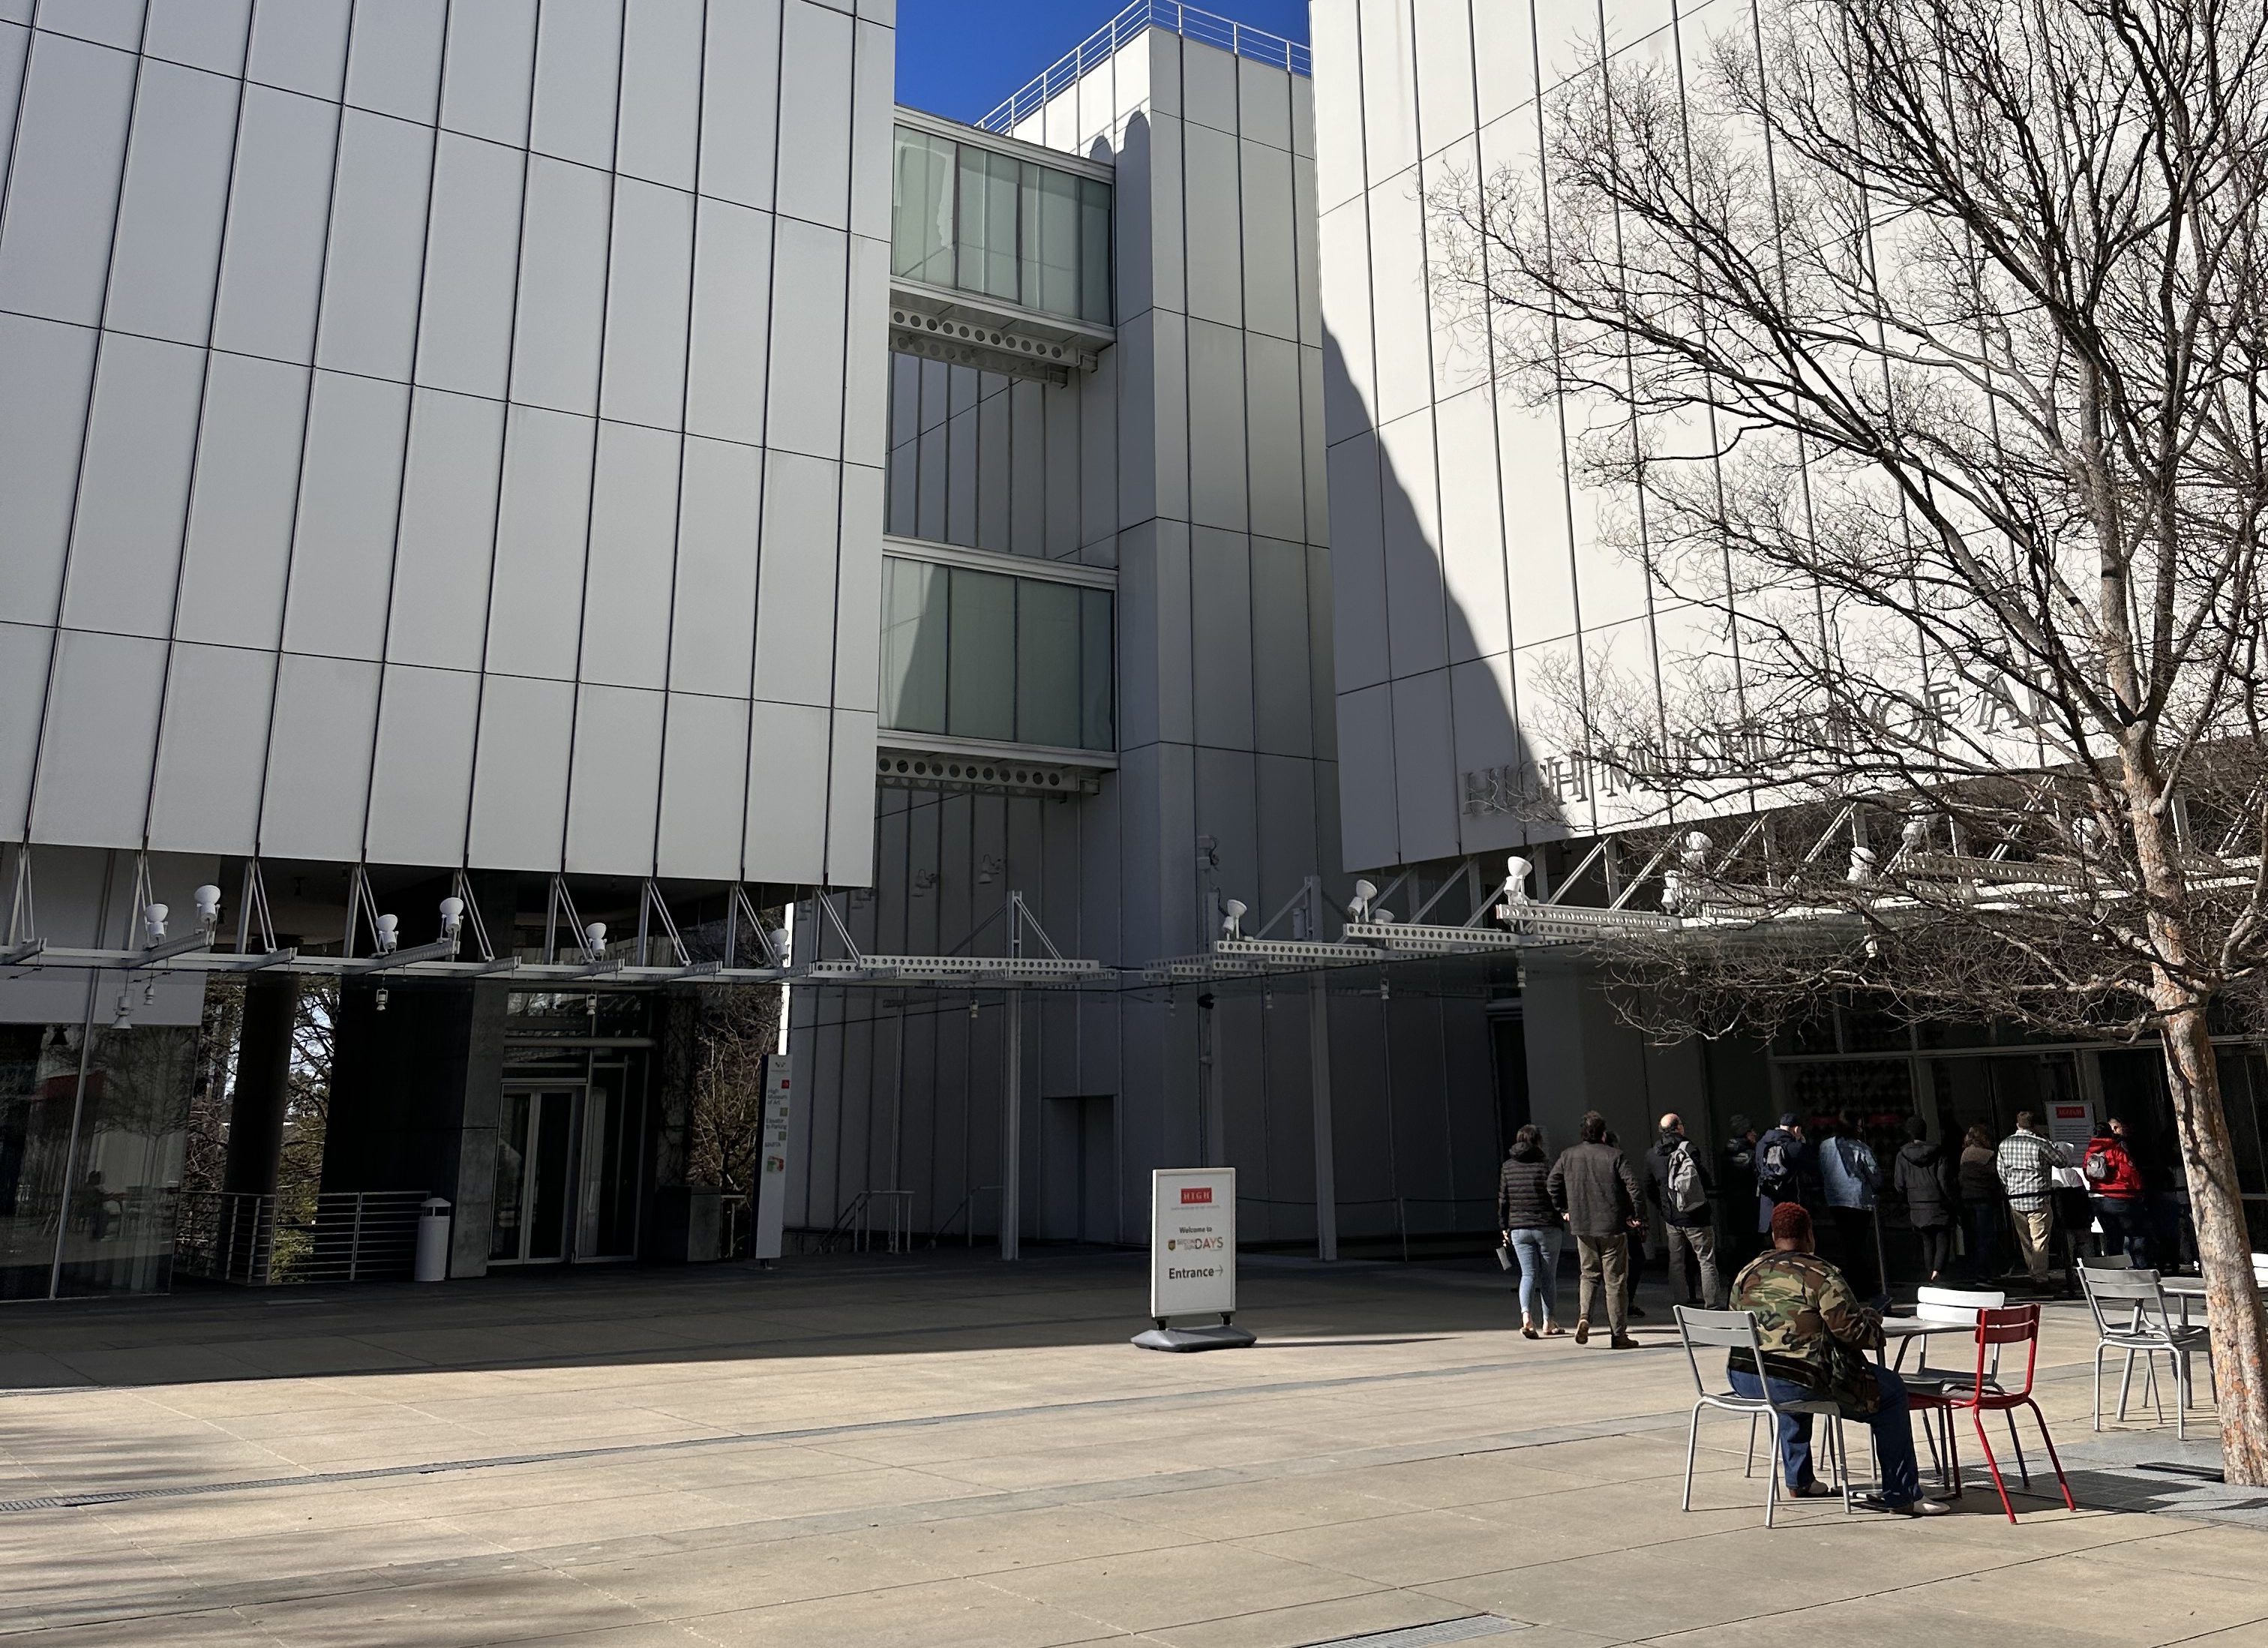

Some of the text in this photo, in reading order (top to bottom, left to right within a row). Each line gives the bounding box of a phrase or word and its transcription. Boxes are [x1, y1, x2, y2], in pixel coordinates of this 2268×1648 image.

[1462, 753, 1591, 815] HIGH
[1870, 680, 1960, 748] OF
[1183, 1191, 1210, 1200] HIGH
[1169, 1268, 1214, 1279] Entrance
